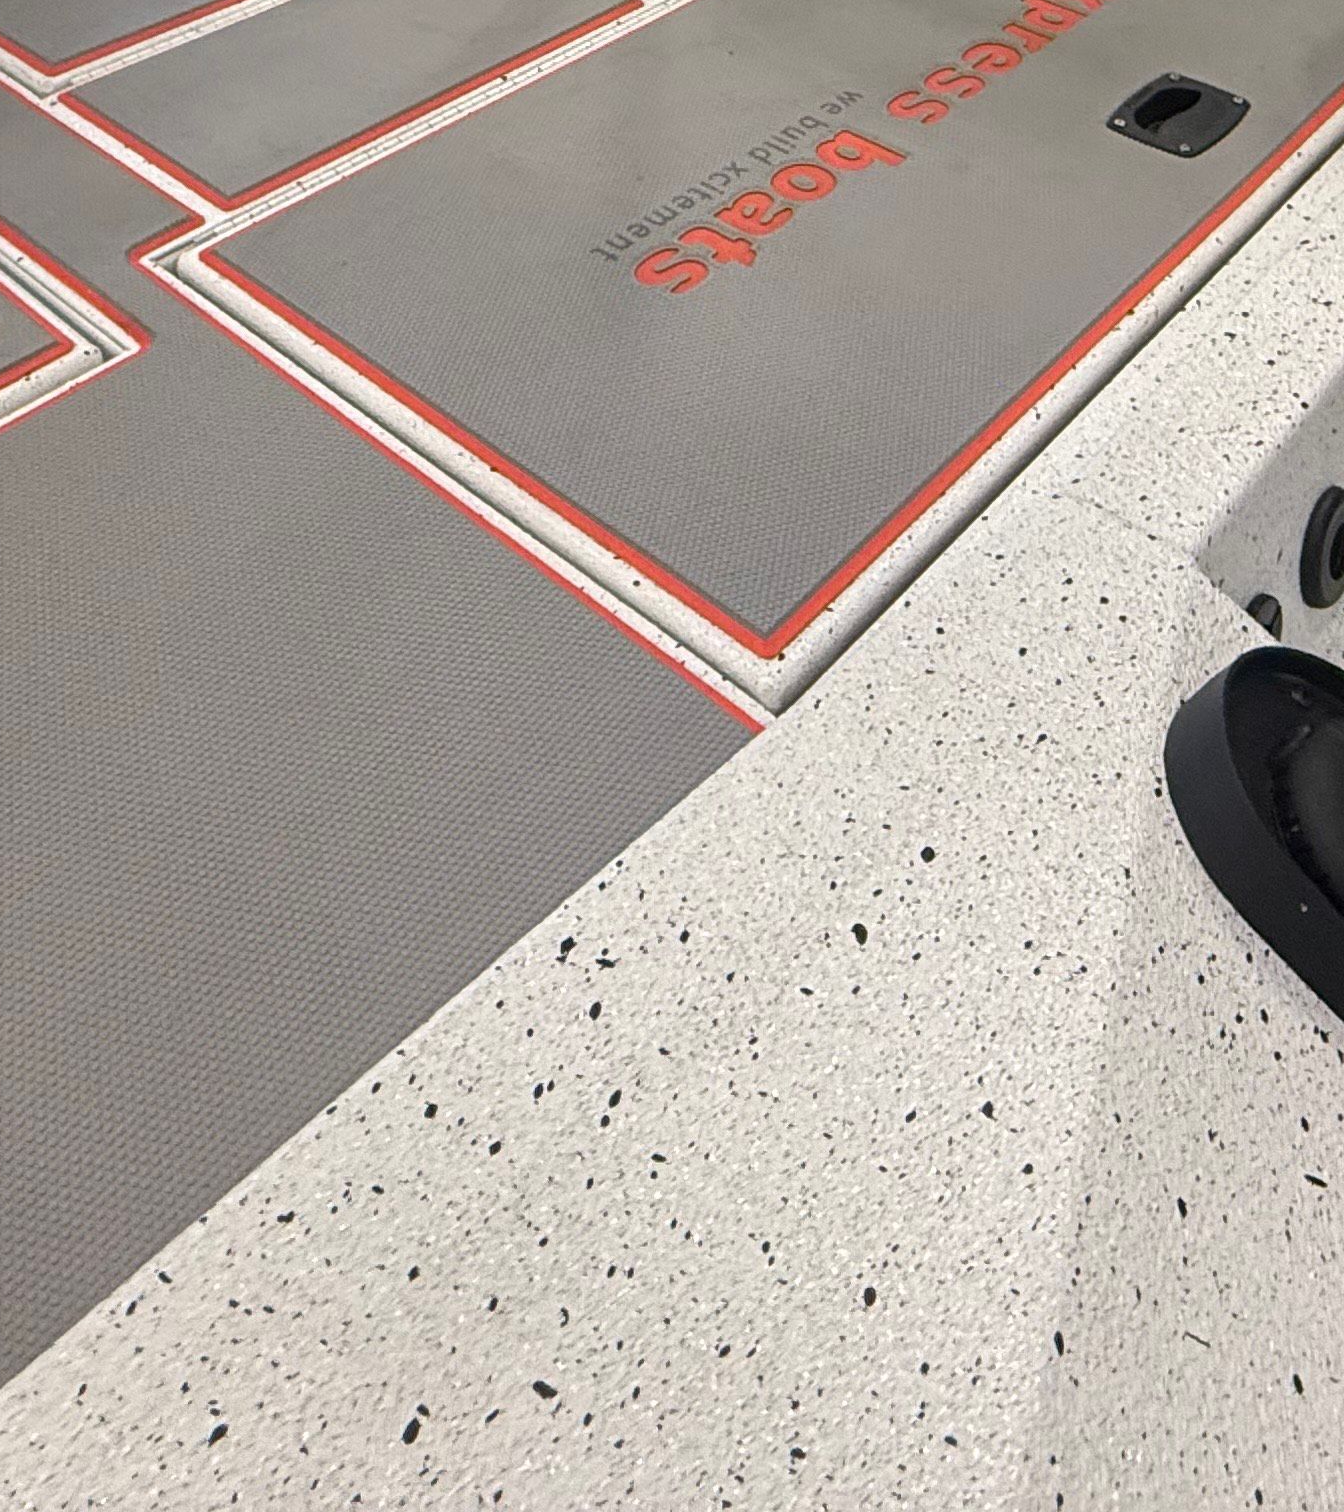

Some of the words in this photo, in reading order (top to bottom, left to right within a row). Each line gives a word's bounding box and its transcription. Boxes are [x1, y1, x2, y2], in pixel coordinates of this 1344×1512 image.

[749, 113, 828, 167] build
[820, 89, 864, 117] we
[590, 160, 749, 264] xcitement
[632, 129, 910, 295] boats
